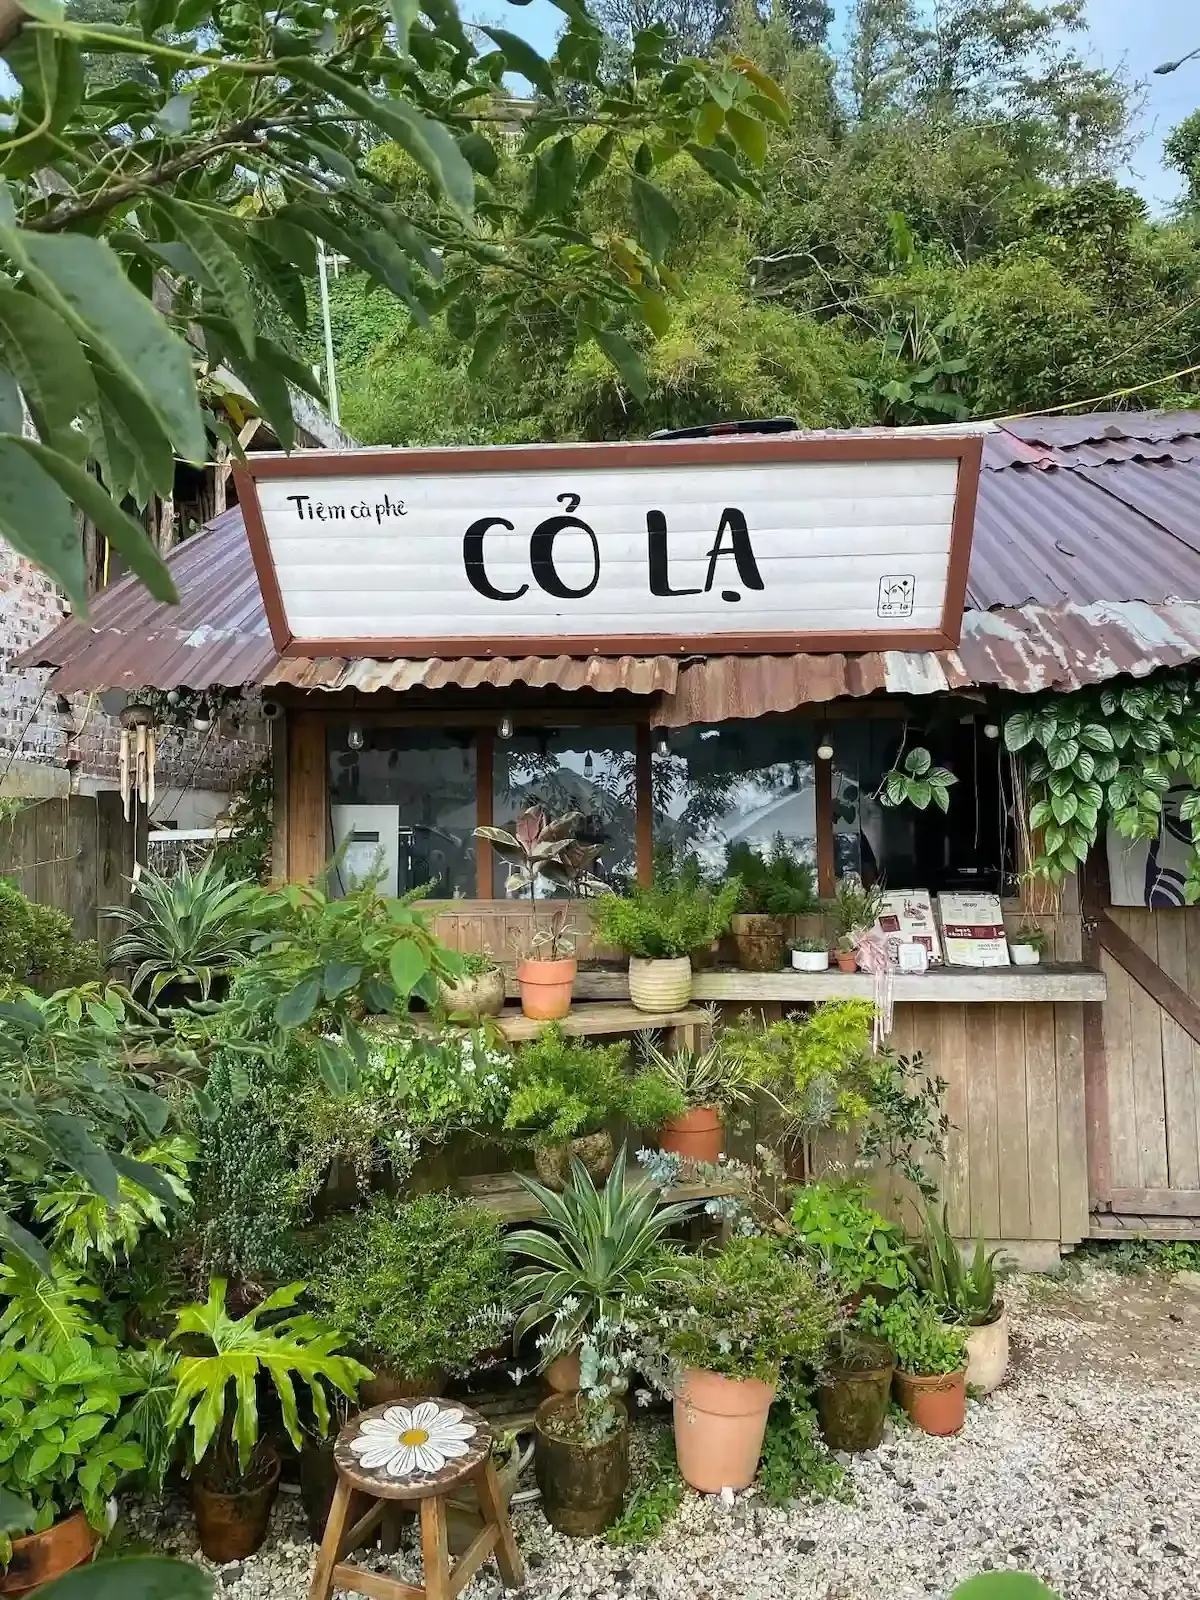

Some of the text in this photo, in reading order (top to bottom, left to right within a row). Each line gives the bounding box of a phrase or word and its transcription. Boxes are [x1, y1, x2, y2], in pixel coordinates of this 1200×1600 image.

[286, 493, 408, 525] Tiệm cà phê
[462, 492, 765, 602] CỎ LẠ
